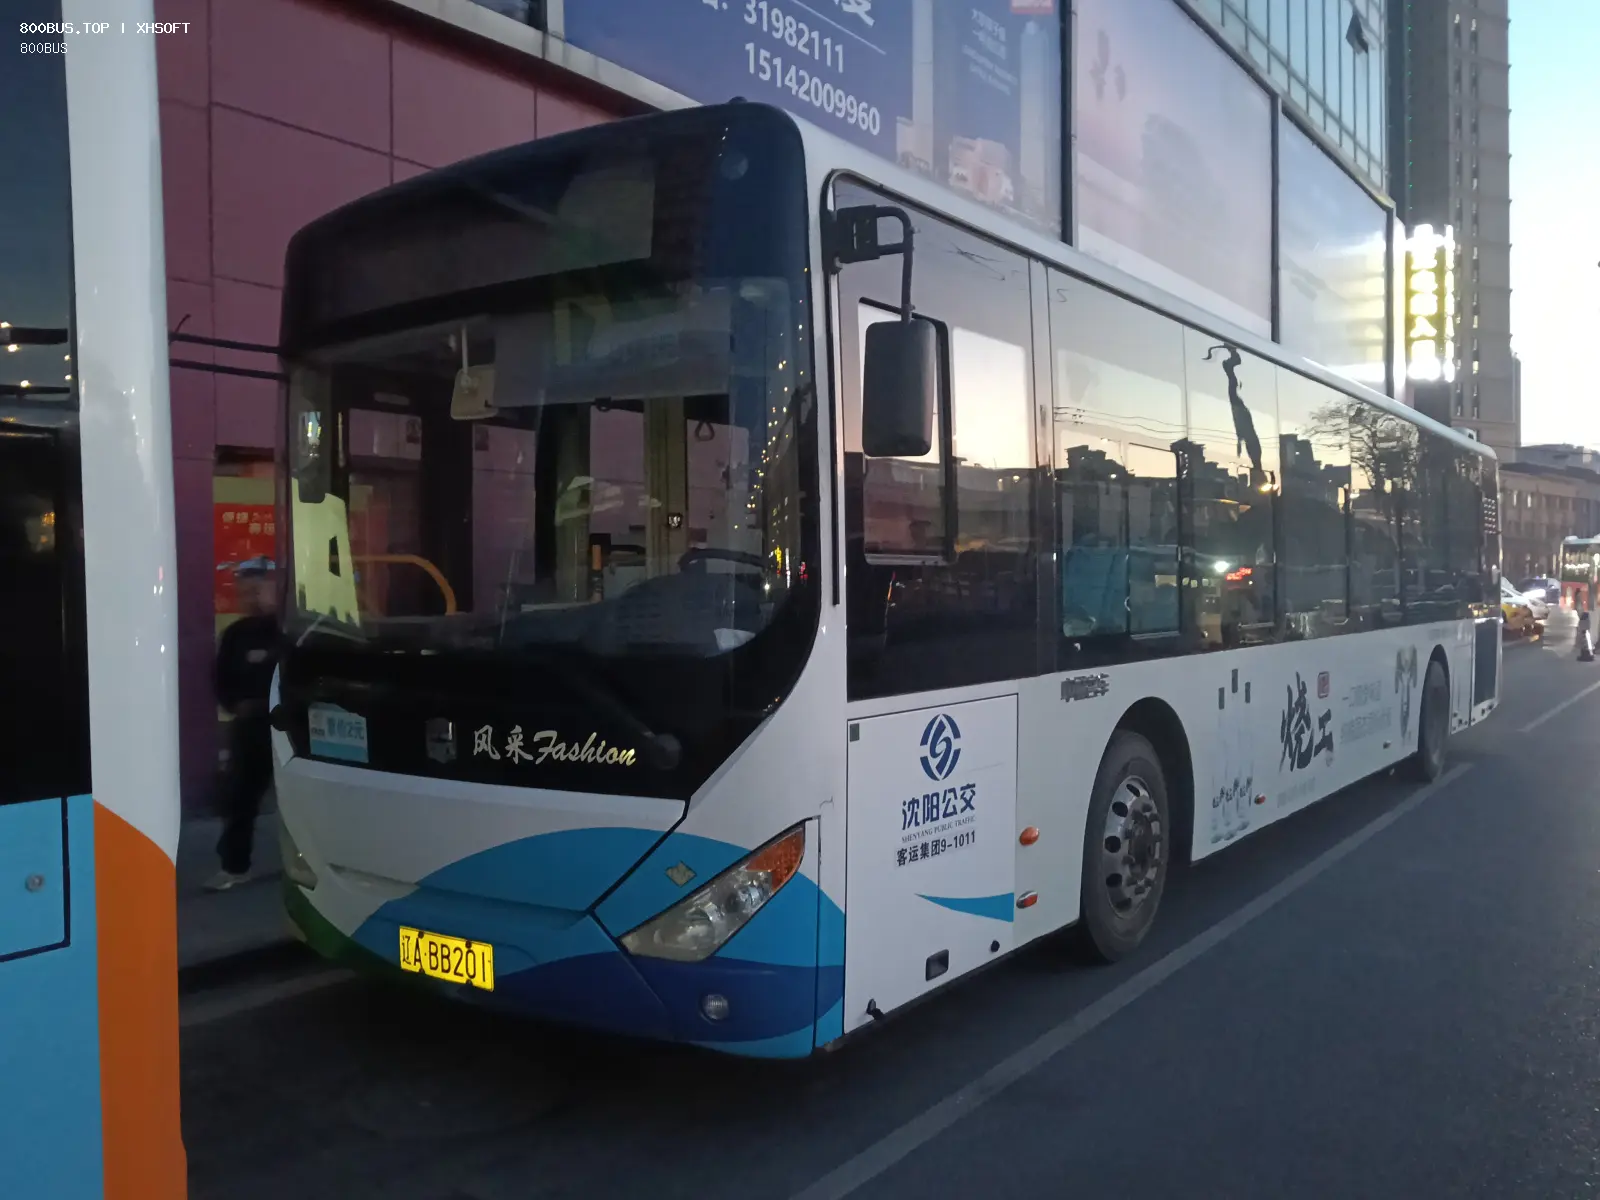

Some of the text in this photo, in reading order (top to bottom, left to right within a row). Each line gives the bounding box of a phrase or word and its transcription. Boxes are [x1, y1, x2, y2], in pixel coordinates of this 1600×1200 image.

[744, 0, 844, 73] 31982111
[745, 42, 881, 136] 15142009960
[473, 724, 637, 767] 风采 Fashion
[902, 783, 976, 831] 沈阳公交
[897, 830, 976, 867] 客运集团9-1011
[901, 827, 933, 843] SHENYANG
[934, 821, 953, 833] PUBLIC
